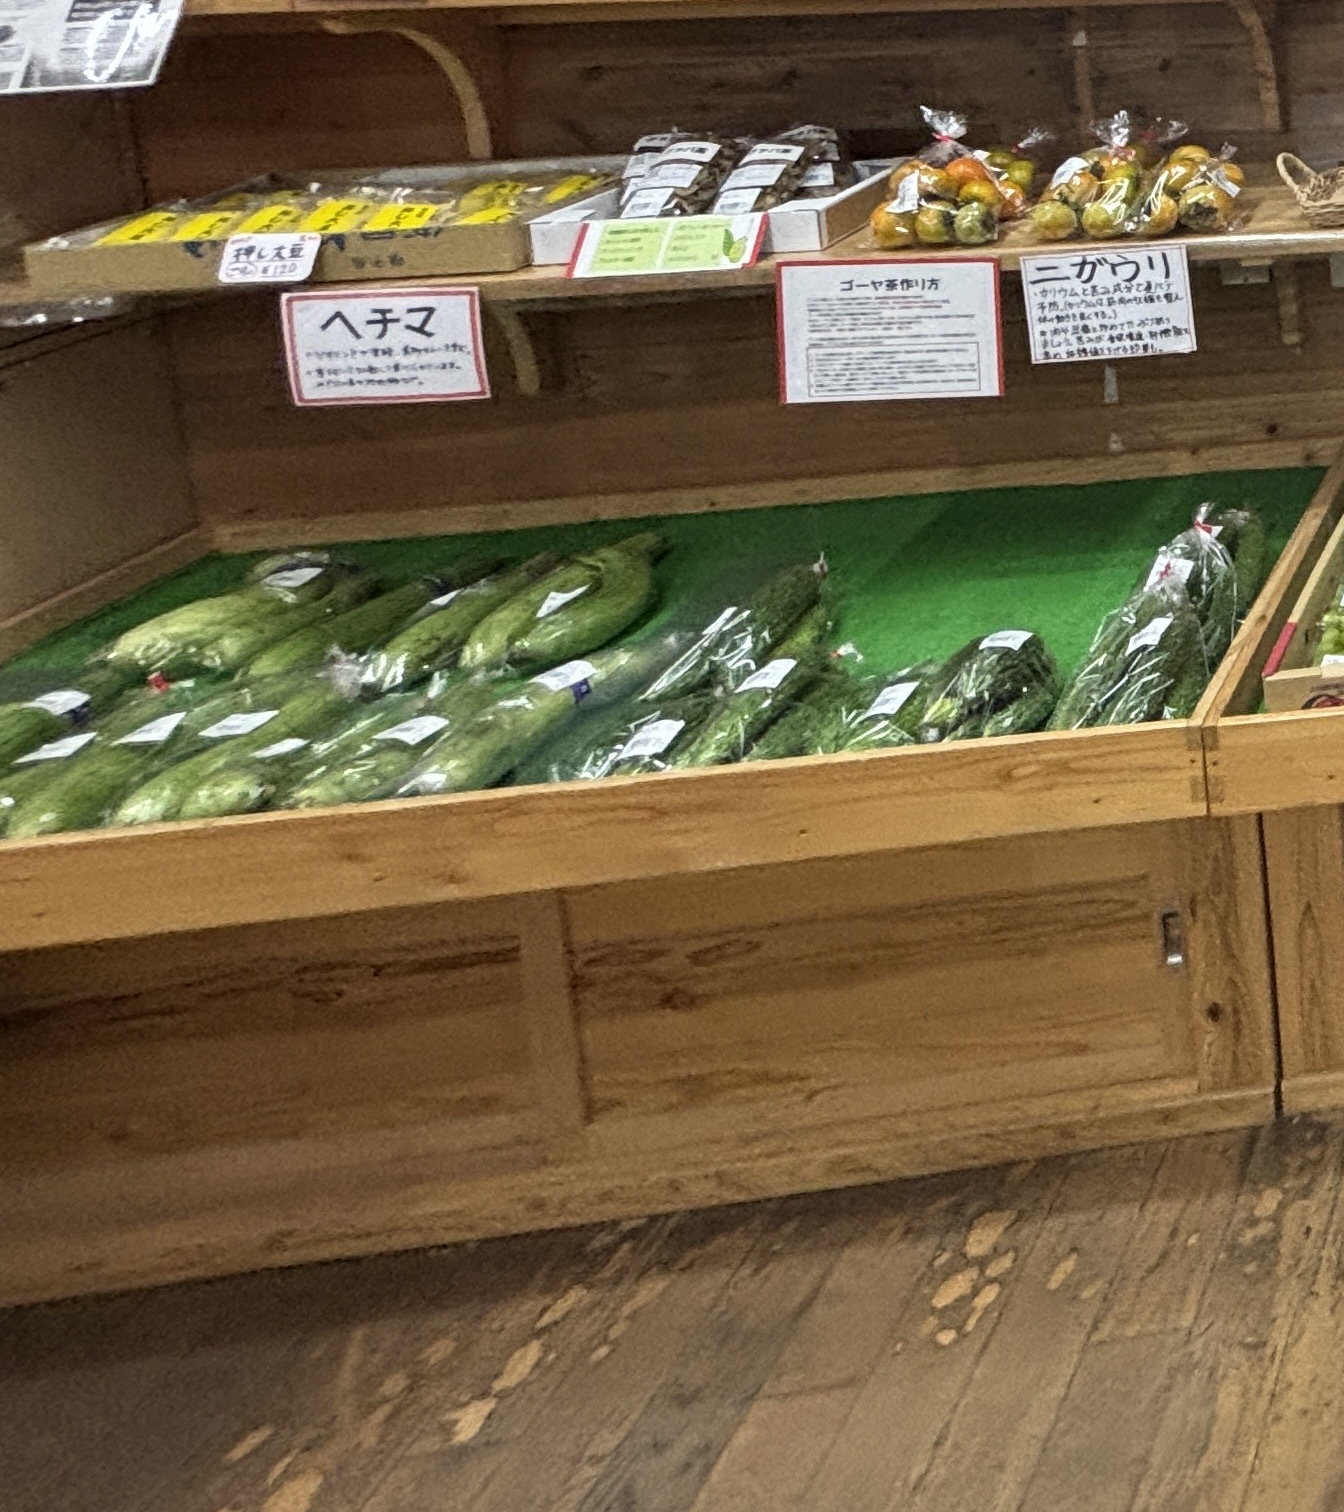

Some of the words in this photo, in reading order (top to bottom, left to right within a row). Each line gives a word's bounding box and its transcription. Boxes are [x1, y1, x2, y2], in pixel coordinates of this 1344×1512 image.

[233, 244, 305, 261] 押し大豆
[1029, 252, 1170, 285] ニガウリ
[840, 278, 940, 293] ゴーヤ茶作り方
[320, 306, 436, 339] ヘチマ
